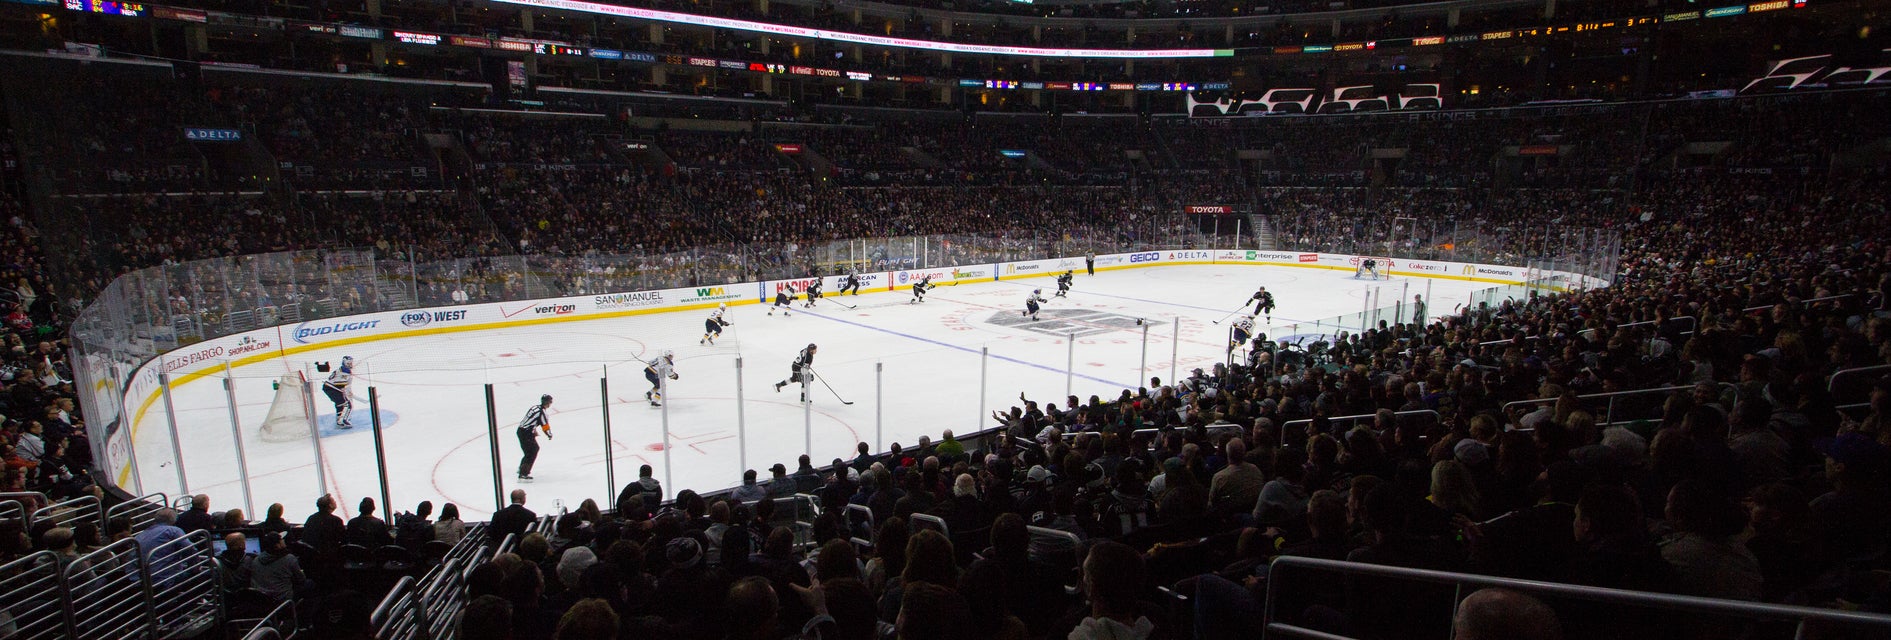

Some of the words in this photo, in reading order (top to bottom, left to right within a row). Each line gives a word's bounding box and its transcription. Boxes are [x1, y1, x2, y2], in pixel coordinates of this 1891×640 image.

[1749, 1, 1788, 12] TOSHIBA
[1482, 31, 1512, 40] STAPLES
[494, 41, 531, 51] TOSHIBA
[631, 54, 655, 62] DELTA
[690, 58, 716, 67] STAPLES
[816, 69, 840, 77] TOYOTA
[200, 130, 240, 139] DELTA
[1130, 252, 1159, 262] GEICO
[1478, 268, 1512, 276] McDonald's
[697, 287, 724, 296] WM
[596, 295, 616, 305] SAN
[624, 292, 663, 302] MANUEL
[535, 304, 576, 314] verizon
[407, 313, 425, 321] FOX
[434, 310, 467, 322] WEST
[299, 325, 331, 339] BUD
[333, 320, 381, 333] LIGHT
[1241, 320, 1252, 331] 22
[228, 341, 270, 356] SHOP.NHL.COM
[190, 346, 223, 364] FARGO
